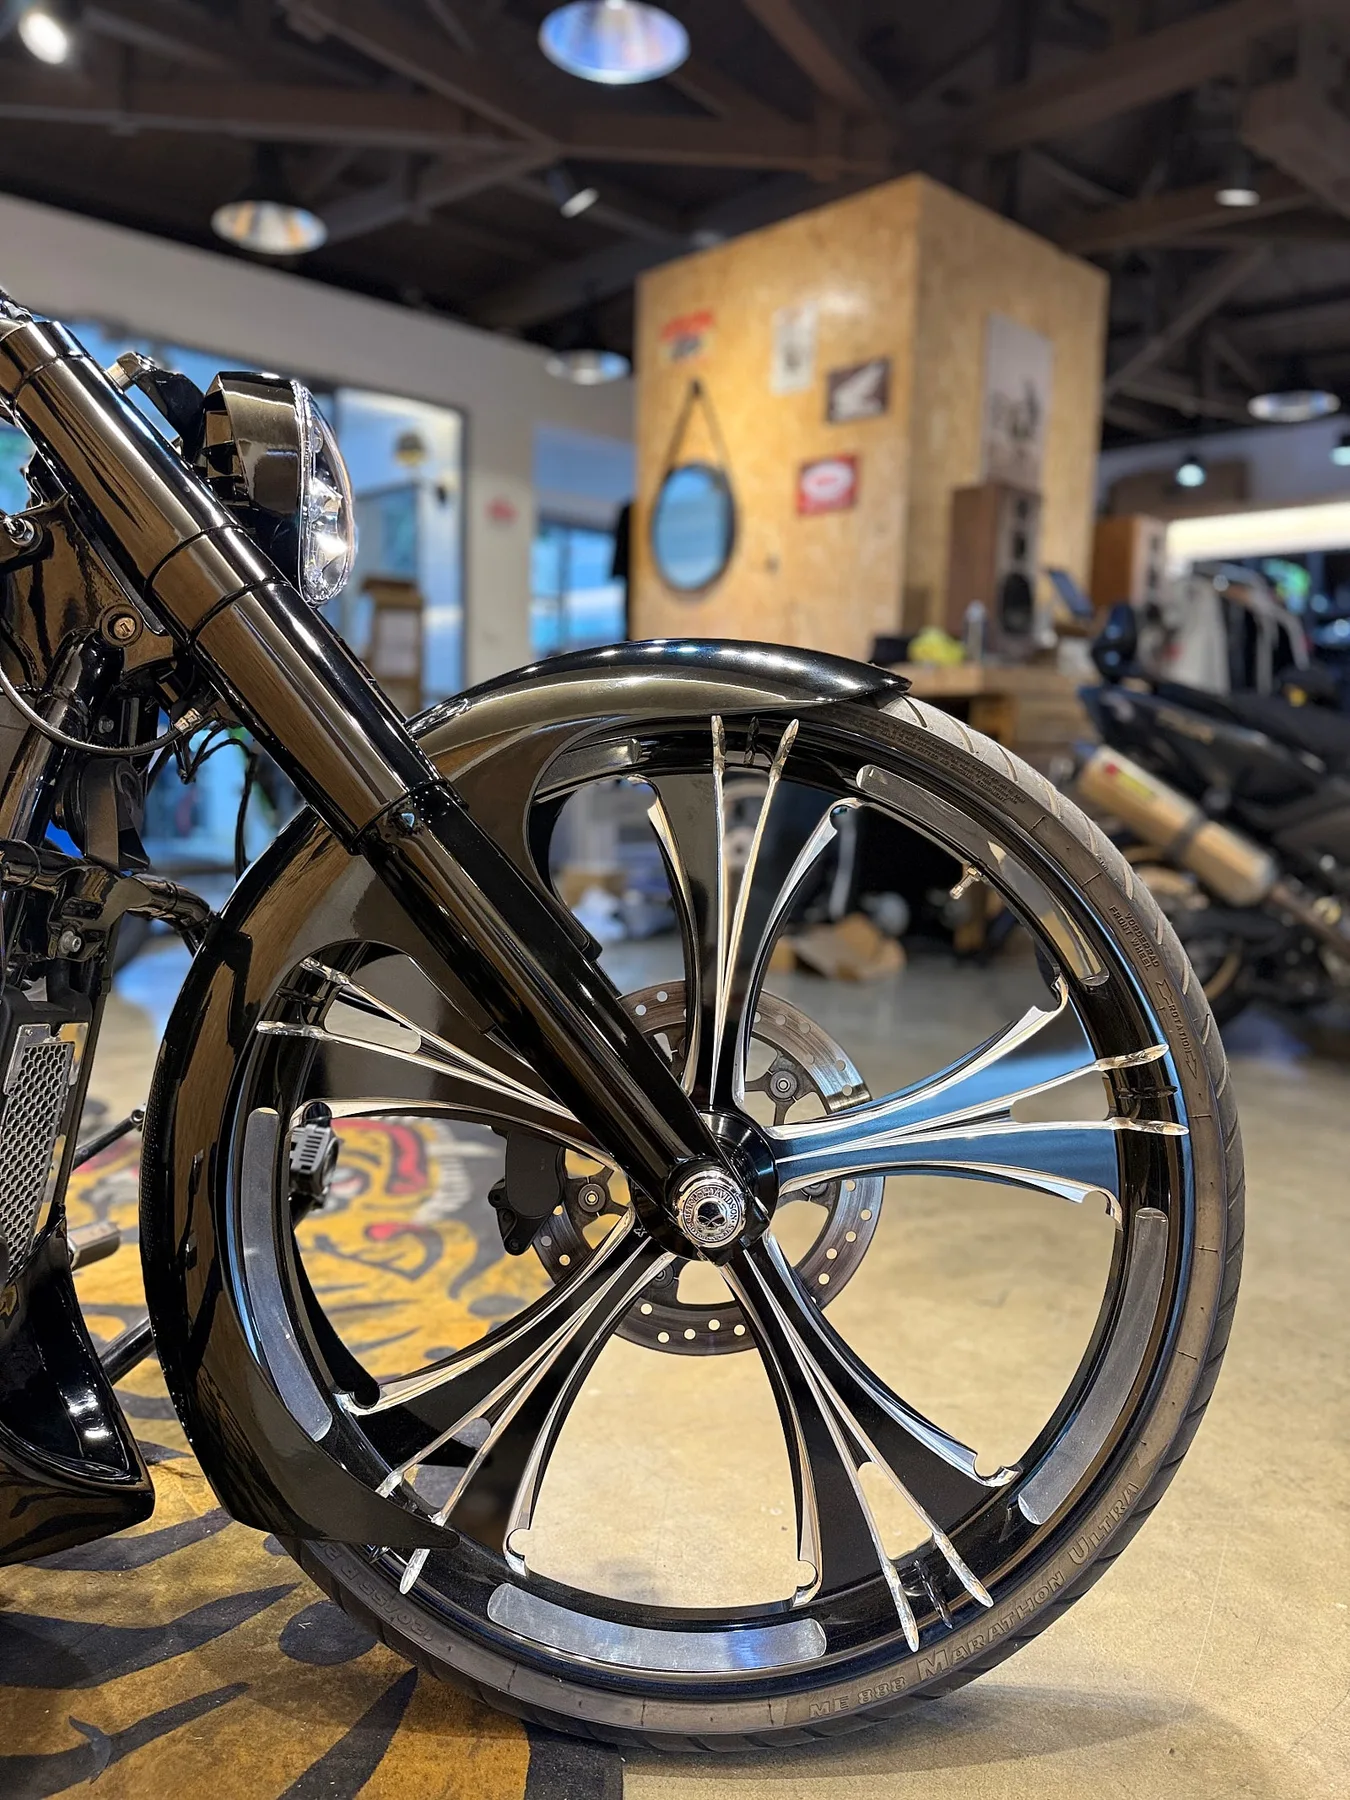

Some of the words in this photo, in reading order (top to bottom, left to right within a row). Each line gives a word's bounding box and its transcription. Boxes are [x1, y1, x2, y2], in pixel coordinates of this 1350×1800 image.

[1108, 904, 1133, 937] FRONT
[1131, 936, 1152, 972] WHEEL
[1124, 912, 1160, 968] VORDERRAD
[1168, 1002, 1194, 1055] ROTATION
[809, 1696, 849, 1719] ME
[857, 1676, 907, 1706] 888
